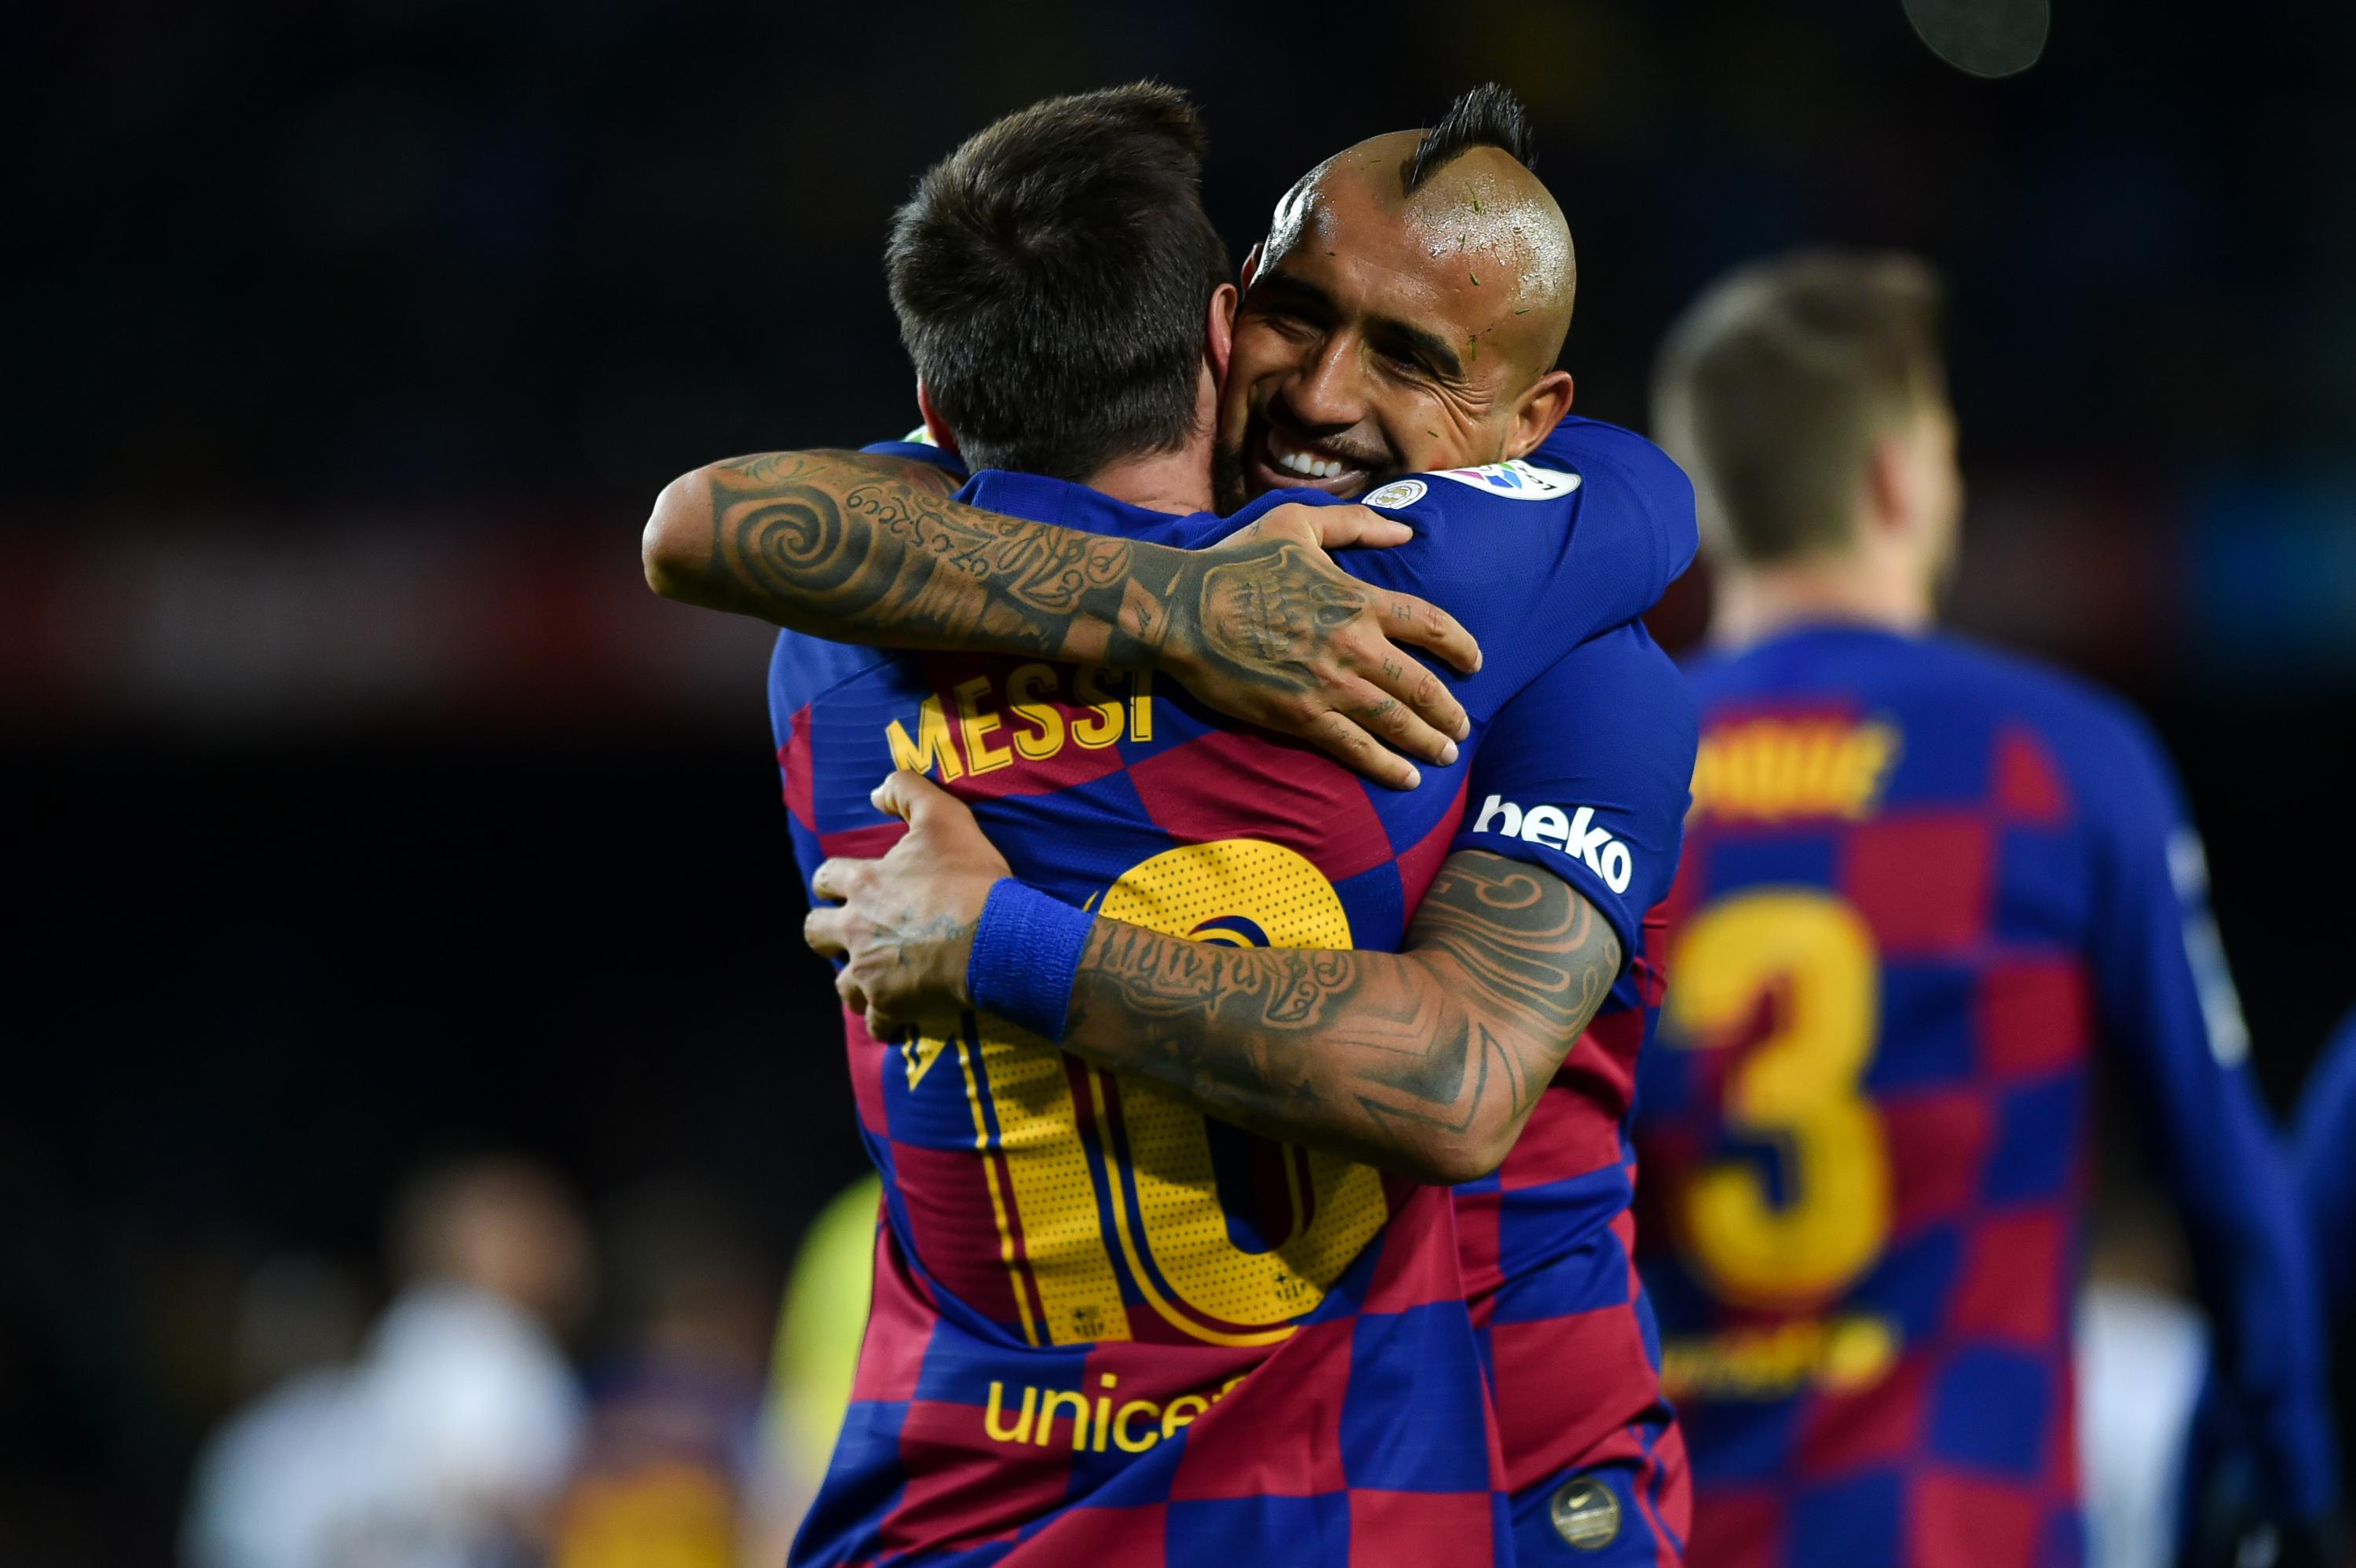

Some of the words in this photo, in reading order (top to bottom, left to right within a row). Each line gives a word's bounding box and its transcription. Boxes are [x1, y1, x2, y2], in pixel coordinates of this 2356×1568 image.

[885, 663, 1152, 784] MESSI
[1473, 795, 1632, 894] beko
[902, 839, 1388, 1347] 10
[1661, 887, 1889, 1307] 3
